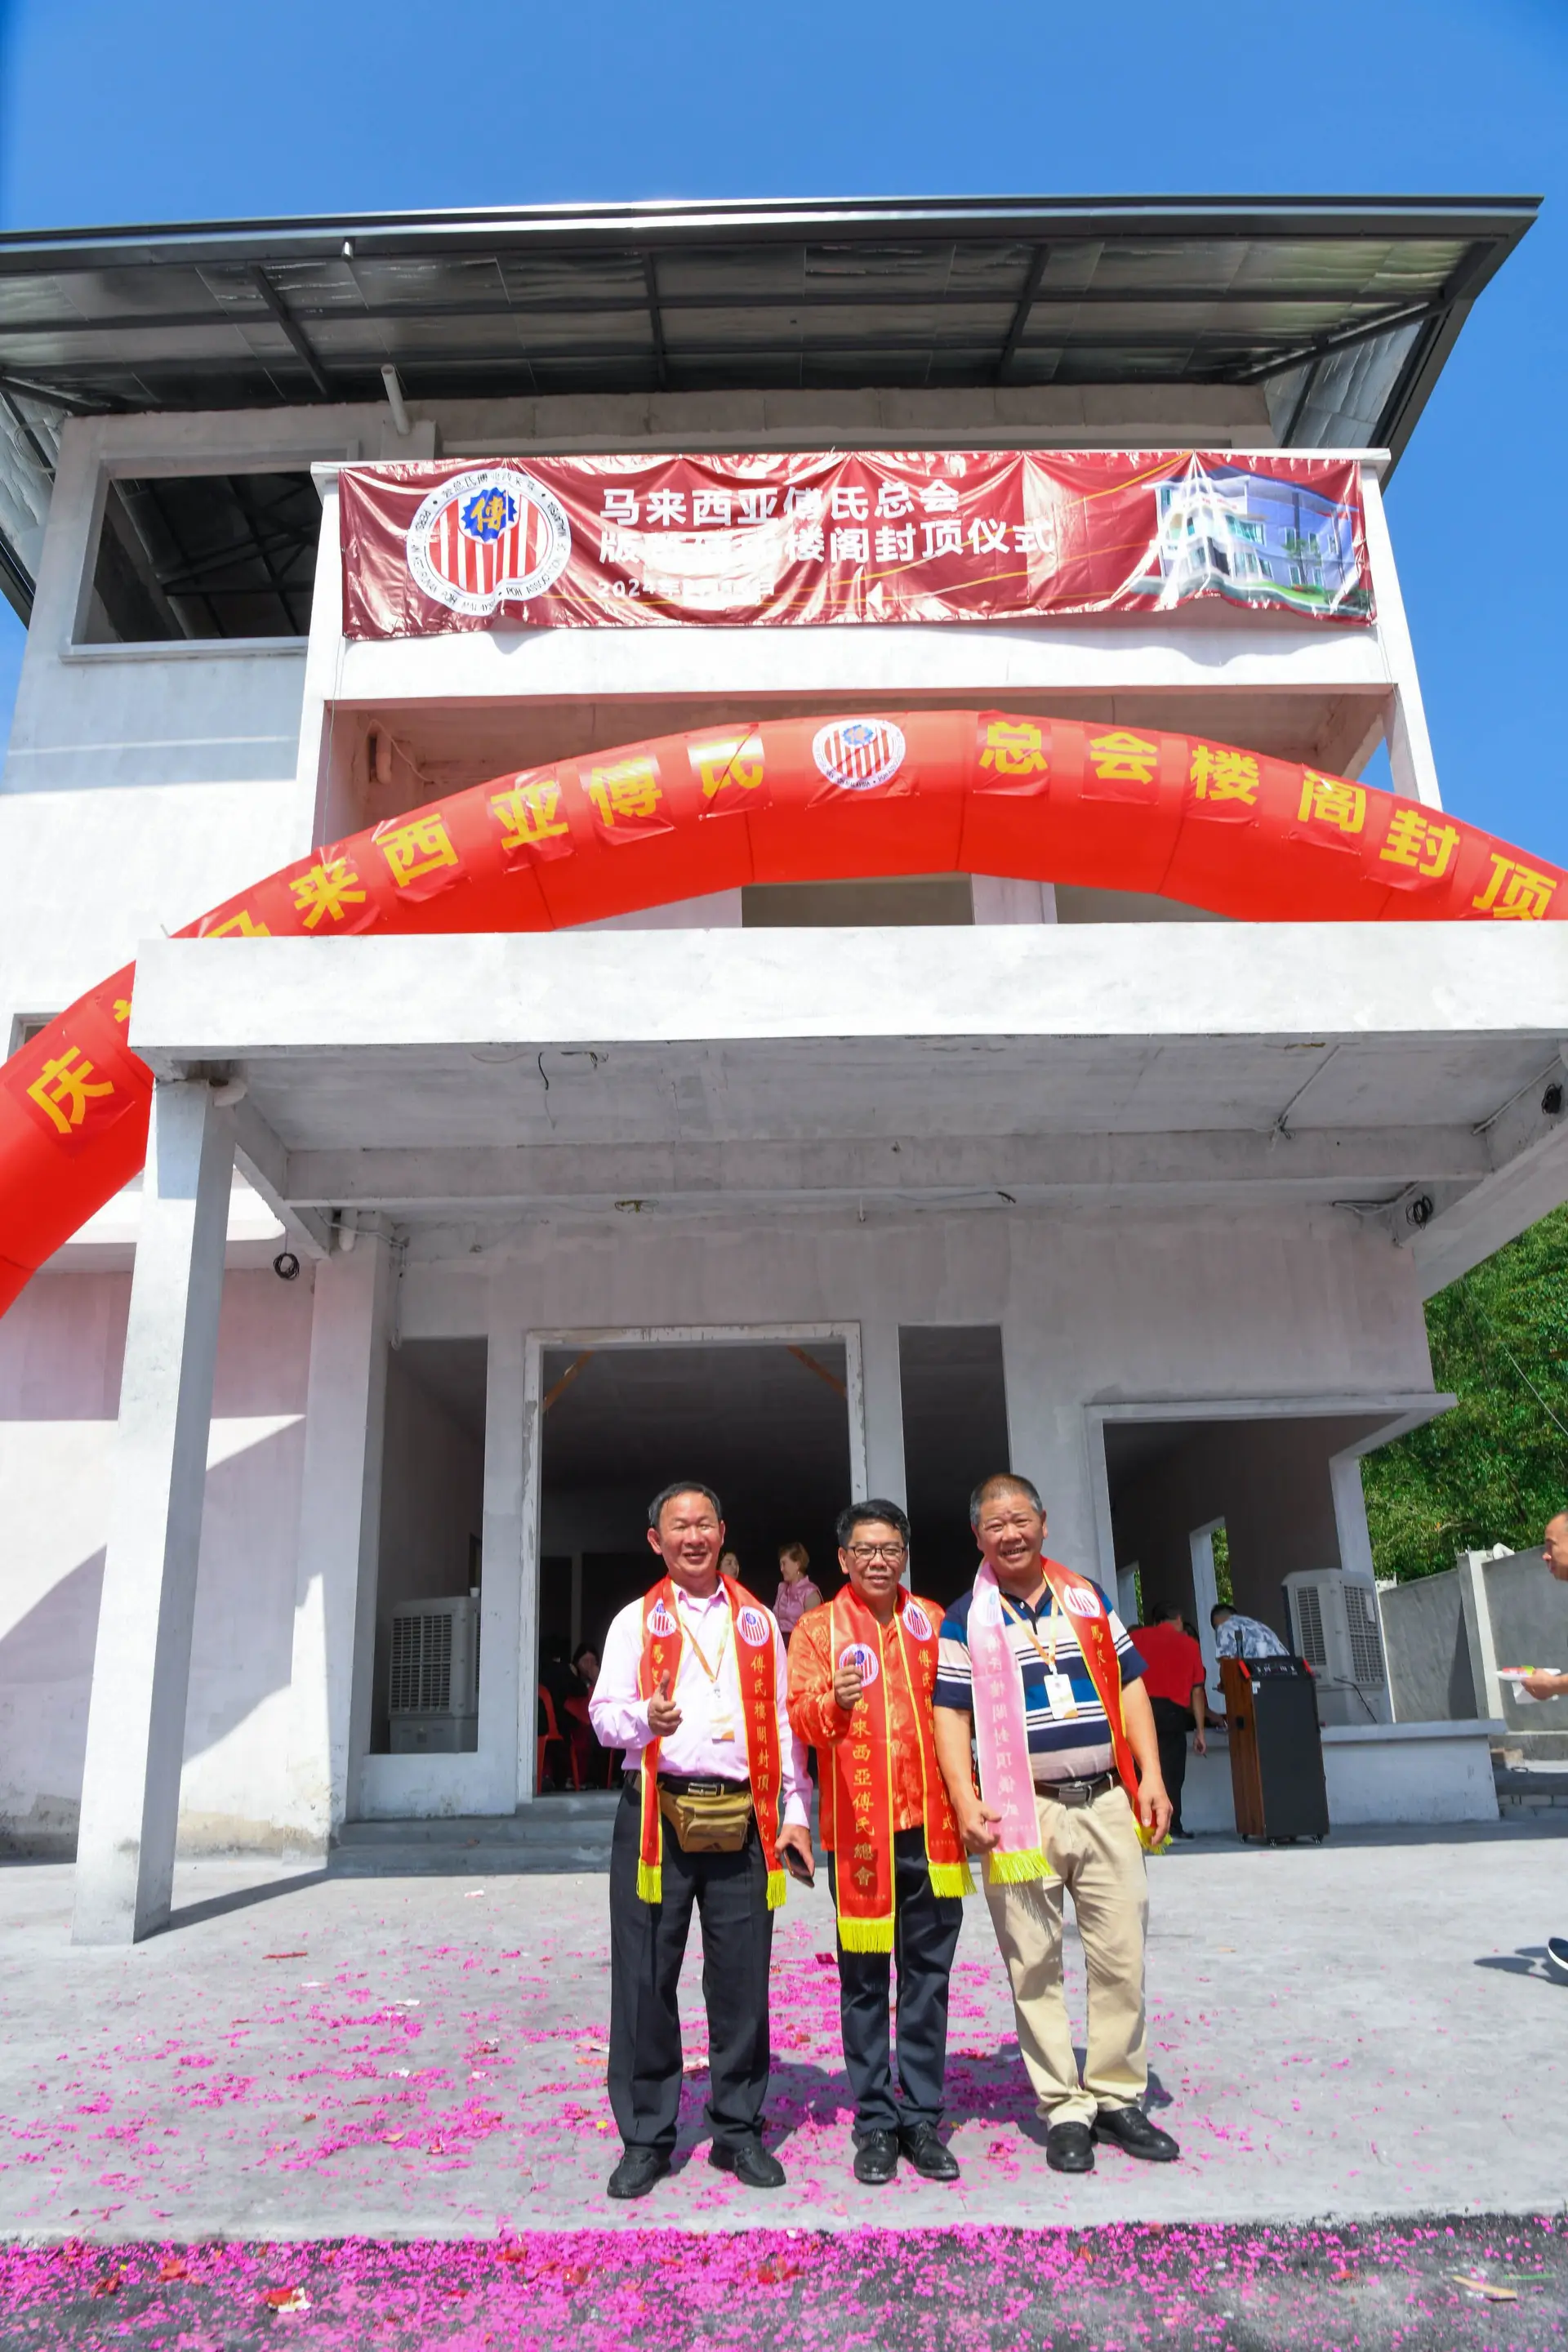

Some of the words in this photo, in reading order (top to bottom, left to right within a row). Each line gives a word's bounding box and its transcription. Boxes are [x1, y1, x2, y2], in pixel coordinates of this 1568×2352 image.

[600, 479, 960, 527] 马来西亚傅氏总会
